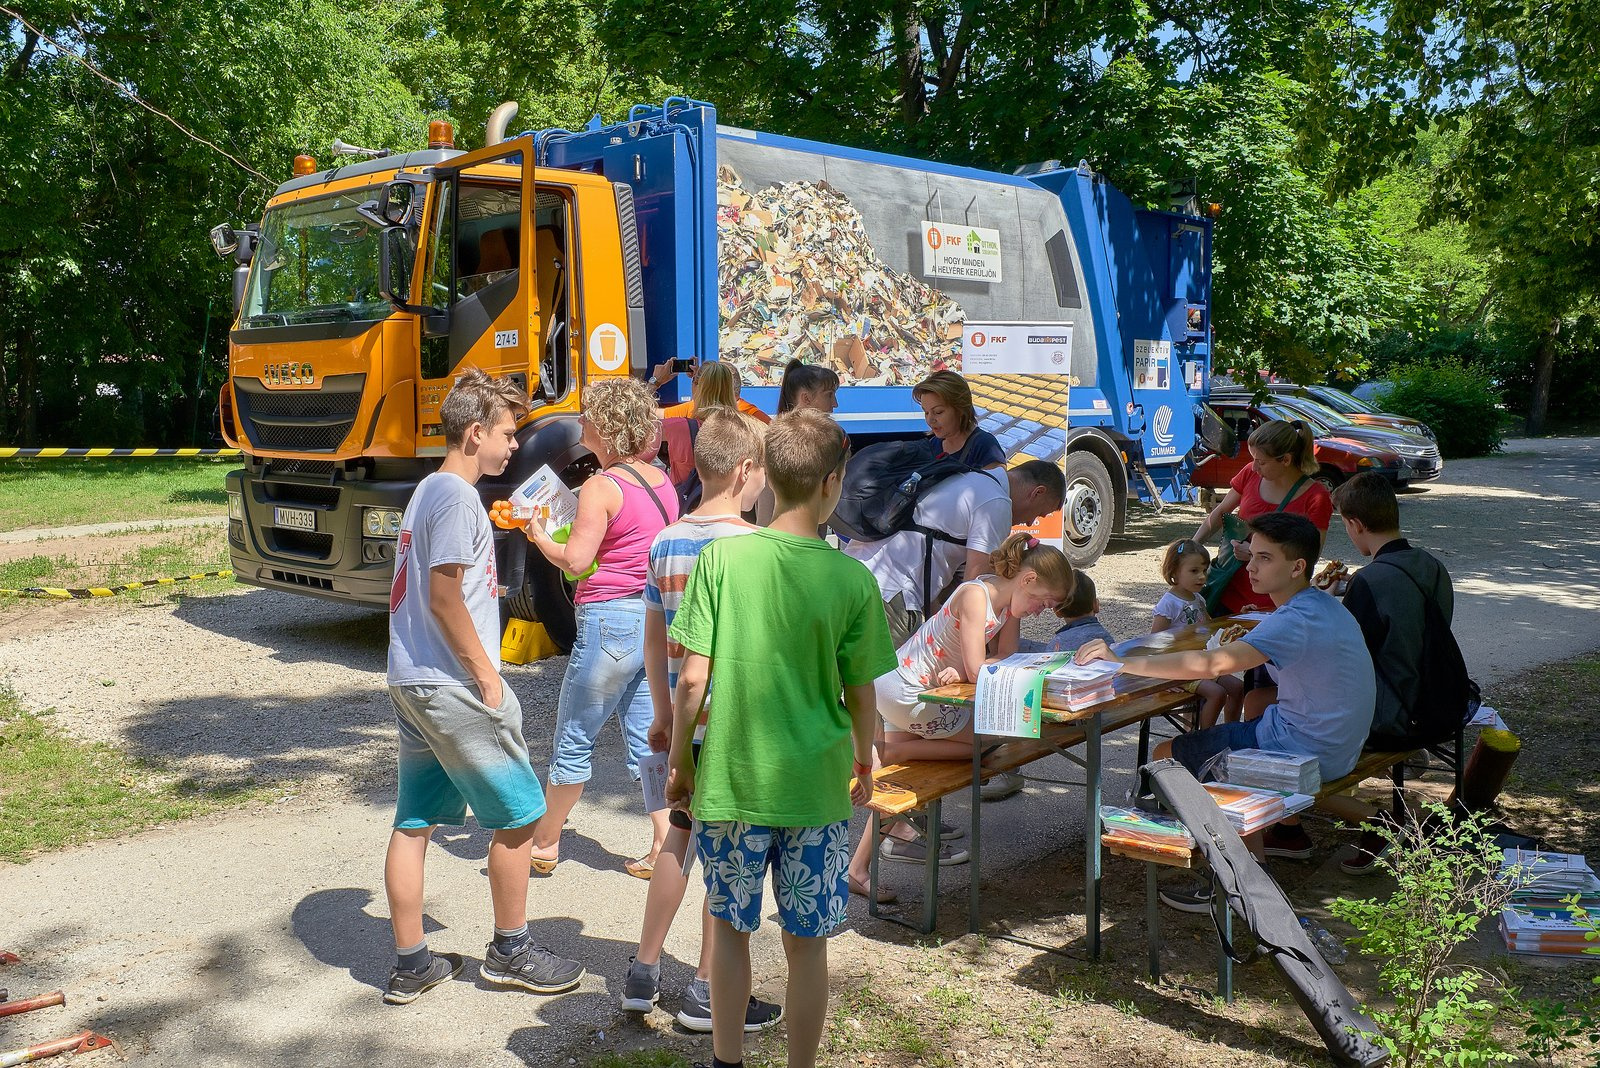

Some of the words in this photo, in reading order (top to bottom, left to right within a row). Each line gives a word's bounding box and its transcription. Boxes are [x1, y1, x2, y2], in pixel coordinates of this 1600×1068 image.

[946, 236, 962, 246] FKF
[943, 256, 961, 266] HOGY
[962, 258, 985, 268] MINDEN
[931, 265, 937, 273] A
[938, 265, 965, 276] HELYÉRE
[965, 266, 997, 278] KERÜLJÖN
[496, 333, 517, 346] 2745
[990, 336, 1007, 344] FKF
[1135, 356, 1156, 367] PAPÍR
[264, 362, 314, 385] IVECO
[1151, 447, 1176, 456] STUMMER
[279, 510, 313, 527] MVH-339
